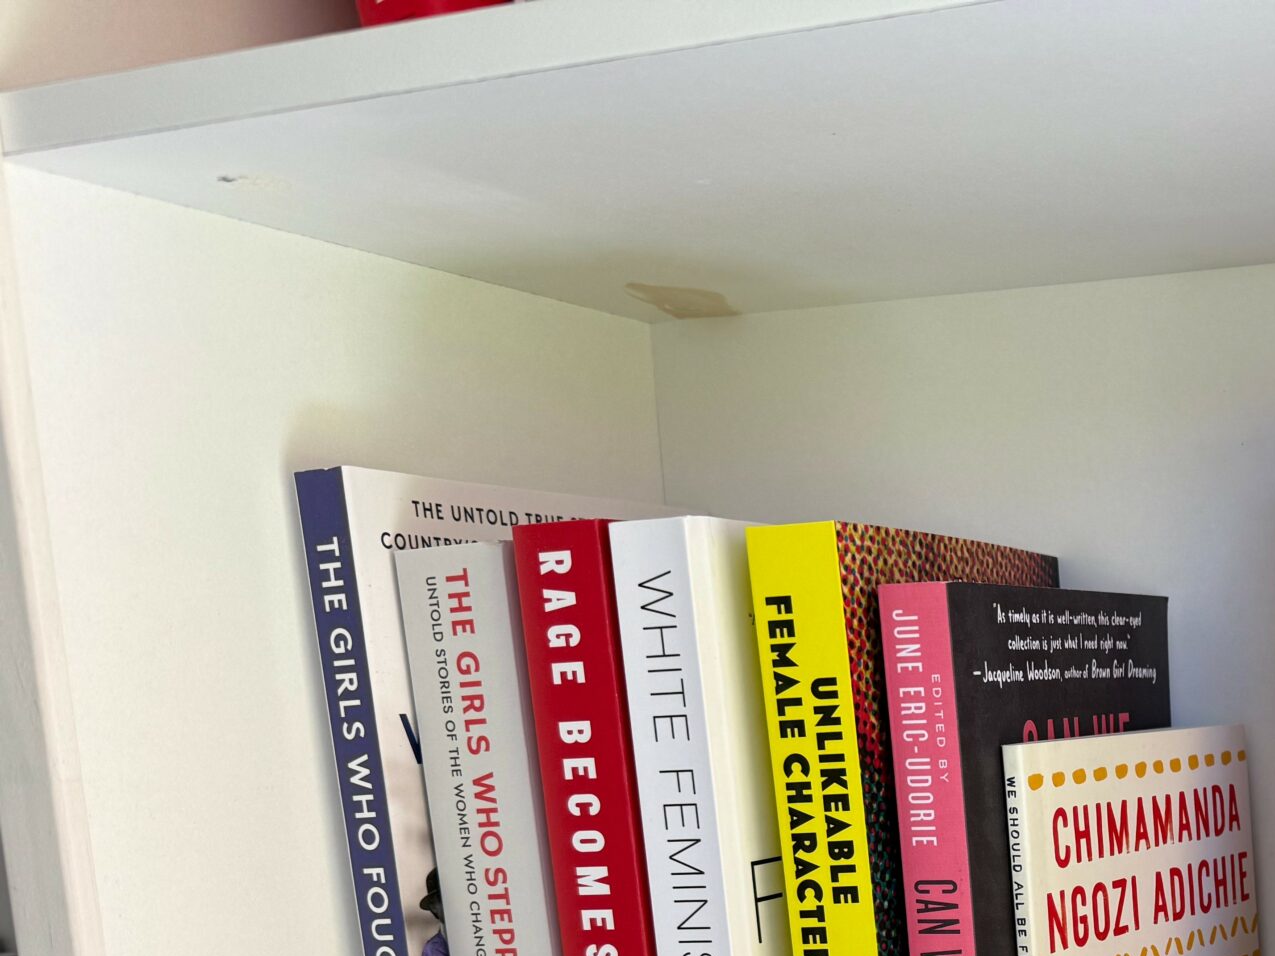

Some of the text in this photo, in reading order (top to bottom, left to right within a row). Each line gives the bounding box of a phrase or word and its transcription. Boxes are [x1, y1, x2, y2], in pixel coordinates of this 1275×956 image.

[412, 501, 444, 520] THE
[451, 505, 519, 527] UNTOLD
[316, 536, 347, 612] THE
[446, 568, 475, 636] THE
[425, 576, 445, 642] UNTOLD
[538, 549, 586, 685] RAGE
[1008, 607, 1141, 628] timely as it is well-written, this clear-eyed
[638, 570, 690, 742] WHITE
[765, 595, 807, 739] FEMALE
[1007, 635, 1040, 651] collection
[1042, 636, 1047, 650] is
[1049, 636, 1062, 653] just
[1064, 634, 1078, 649] what
[1084, 634, 1098, 649] need
[1100, 633, 1114, 654] right
[1027, 660, 1063, 682] Woodson,
[1064, 667, 1082, 680] author
[1083, 664, 1089, 678] of
[1092, 658, 1111, 679] Brown
[1113, 660, 1125, 678] Girl
[1127, 659, 1157, 684] Dreaming
[330, 627, 365, 740] GIRLS
[435, 648, 454, 714] STORIES
[456, 651, 491, 755] GIRLS
[445, 718, 457, 741] OF
[892, 609, 937, 847] JUNE ERIC-UDORIE
[932, 674, 949, 782] EDITED BY
[448, 747, 463, 777] THE
[810, 677, 860, 905] UNLIKEABLE
[1006, 777, 1017, 798] WE
[347, 754, 380, 851] WHO
[454, 783, 472, 848] WOMEN
[471, 772, 504, 857] WHO
[1052, 783, 1241, 869] CHIMAMANDA
[1008, 807, 1023, 873] SHOULD
[463, 855, 477, 895] WHO
[914, 880, 961, 934] CAN
[1015, 882, 1025, 910] ALL
[1046, 851, 1251, 954] NGOZI ADICHIE
[1017, 918, 1027, 937] BE
